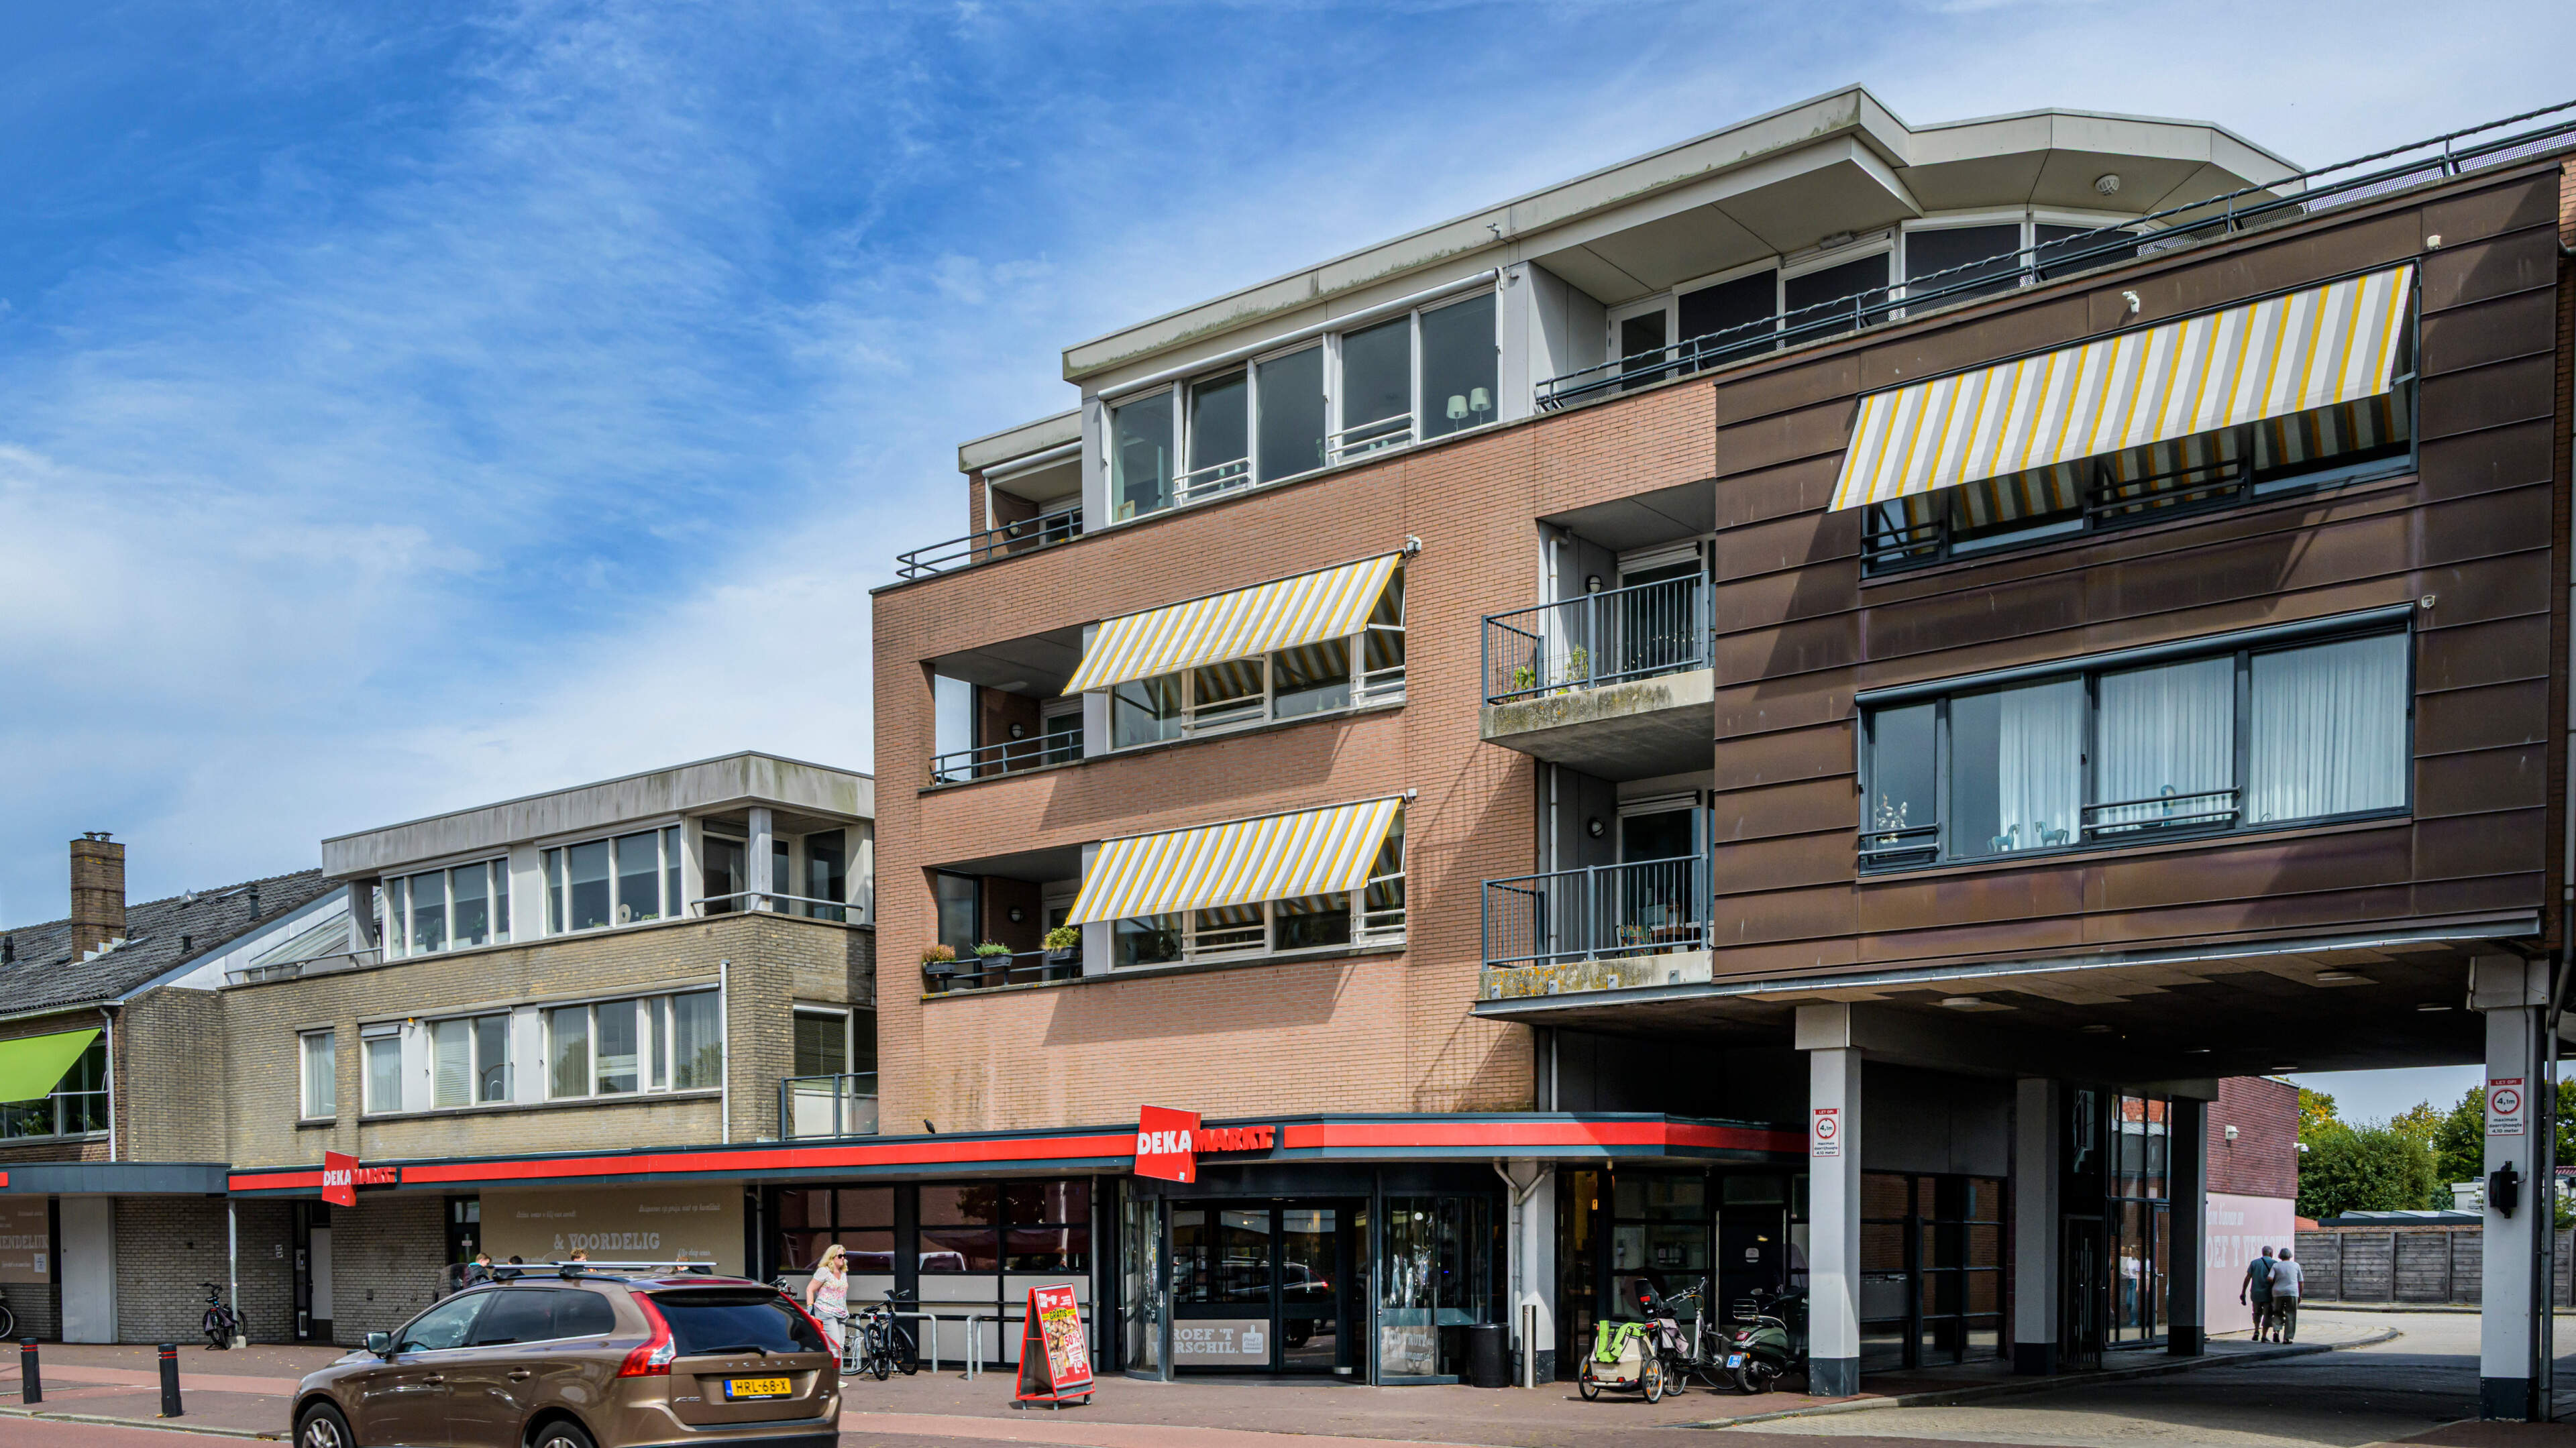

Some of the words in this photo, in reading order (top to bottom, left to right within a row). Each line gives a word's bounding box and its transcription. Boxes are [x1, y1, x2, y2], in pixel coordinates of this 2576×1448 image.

[554, 1233, 564, 1250] &
[568, 1233, 661, 1251] VOORDELIG
[1049, 1308, 1067, 1320] GRATIS
[1064, 1330, 1081, 1347] 50%
[1174, 1329, 1215, 1341] ROEF
[735, 1380, 788, 1394] HRL-68-X
